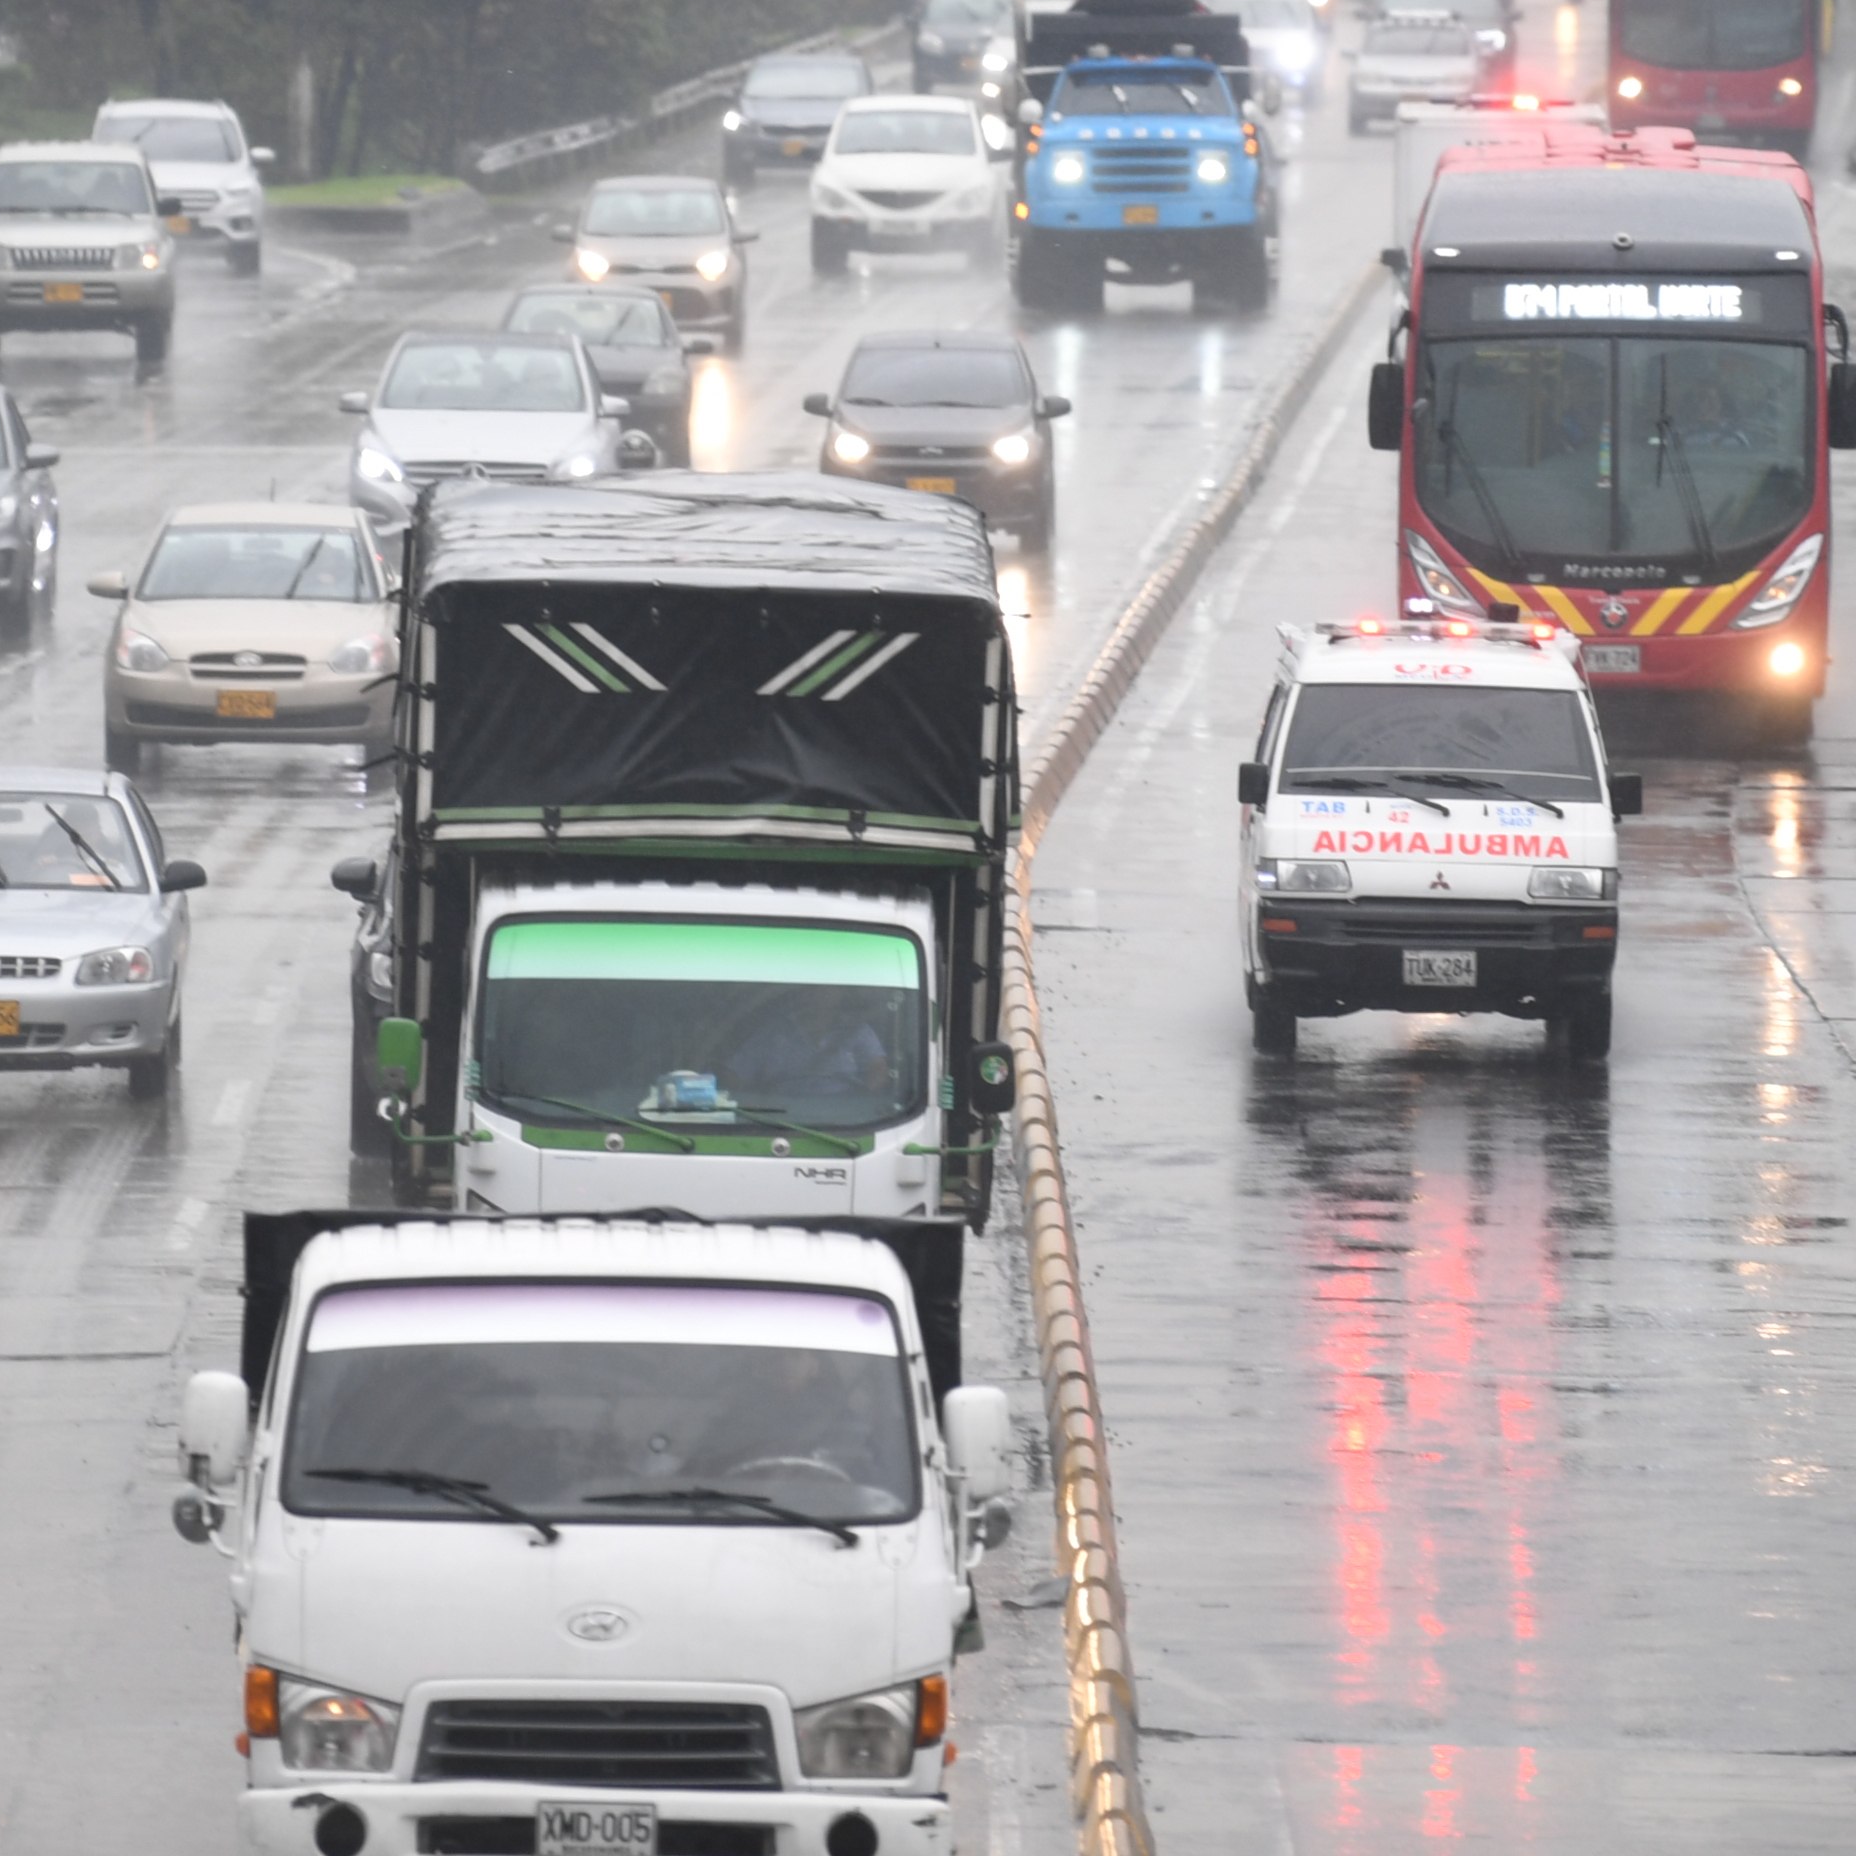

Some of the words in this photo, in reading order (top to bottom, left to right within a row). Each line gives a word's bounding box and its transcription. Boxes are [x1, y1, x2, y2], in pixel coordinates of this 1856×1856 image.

[1302, 801, 1346, 814] TAB
[1388, 811, 1410, 823] 42
[794, 1167, 846, 1179] NHR
[544, 1809, 651, 1843] XMD-005
